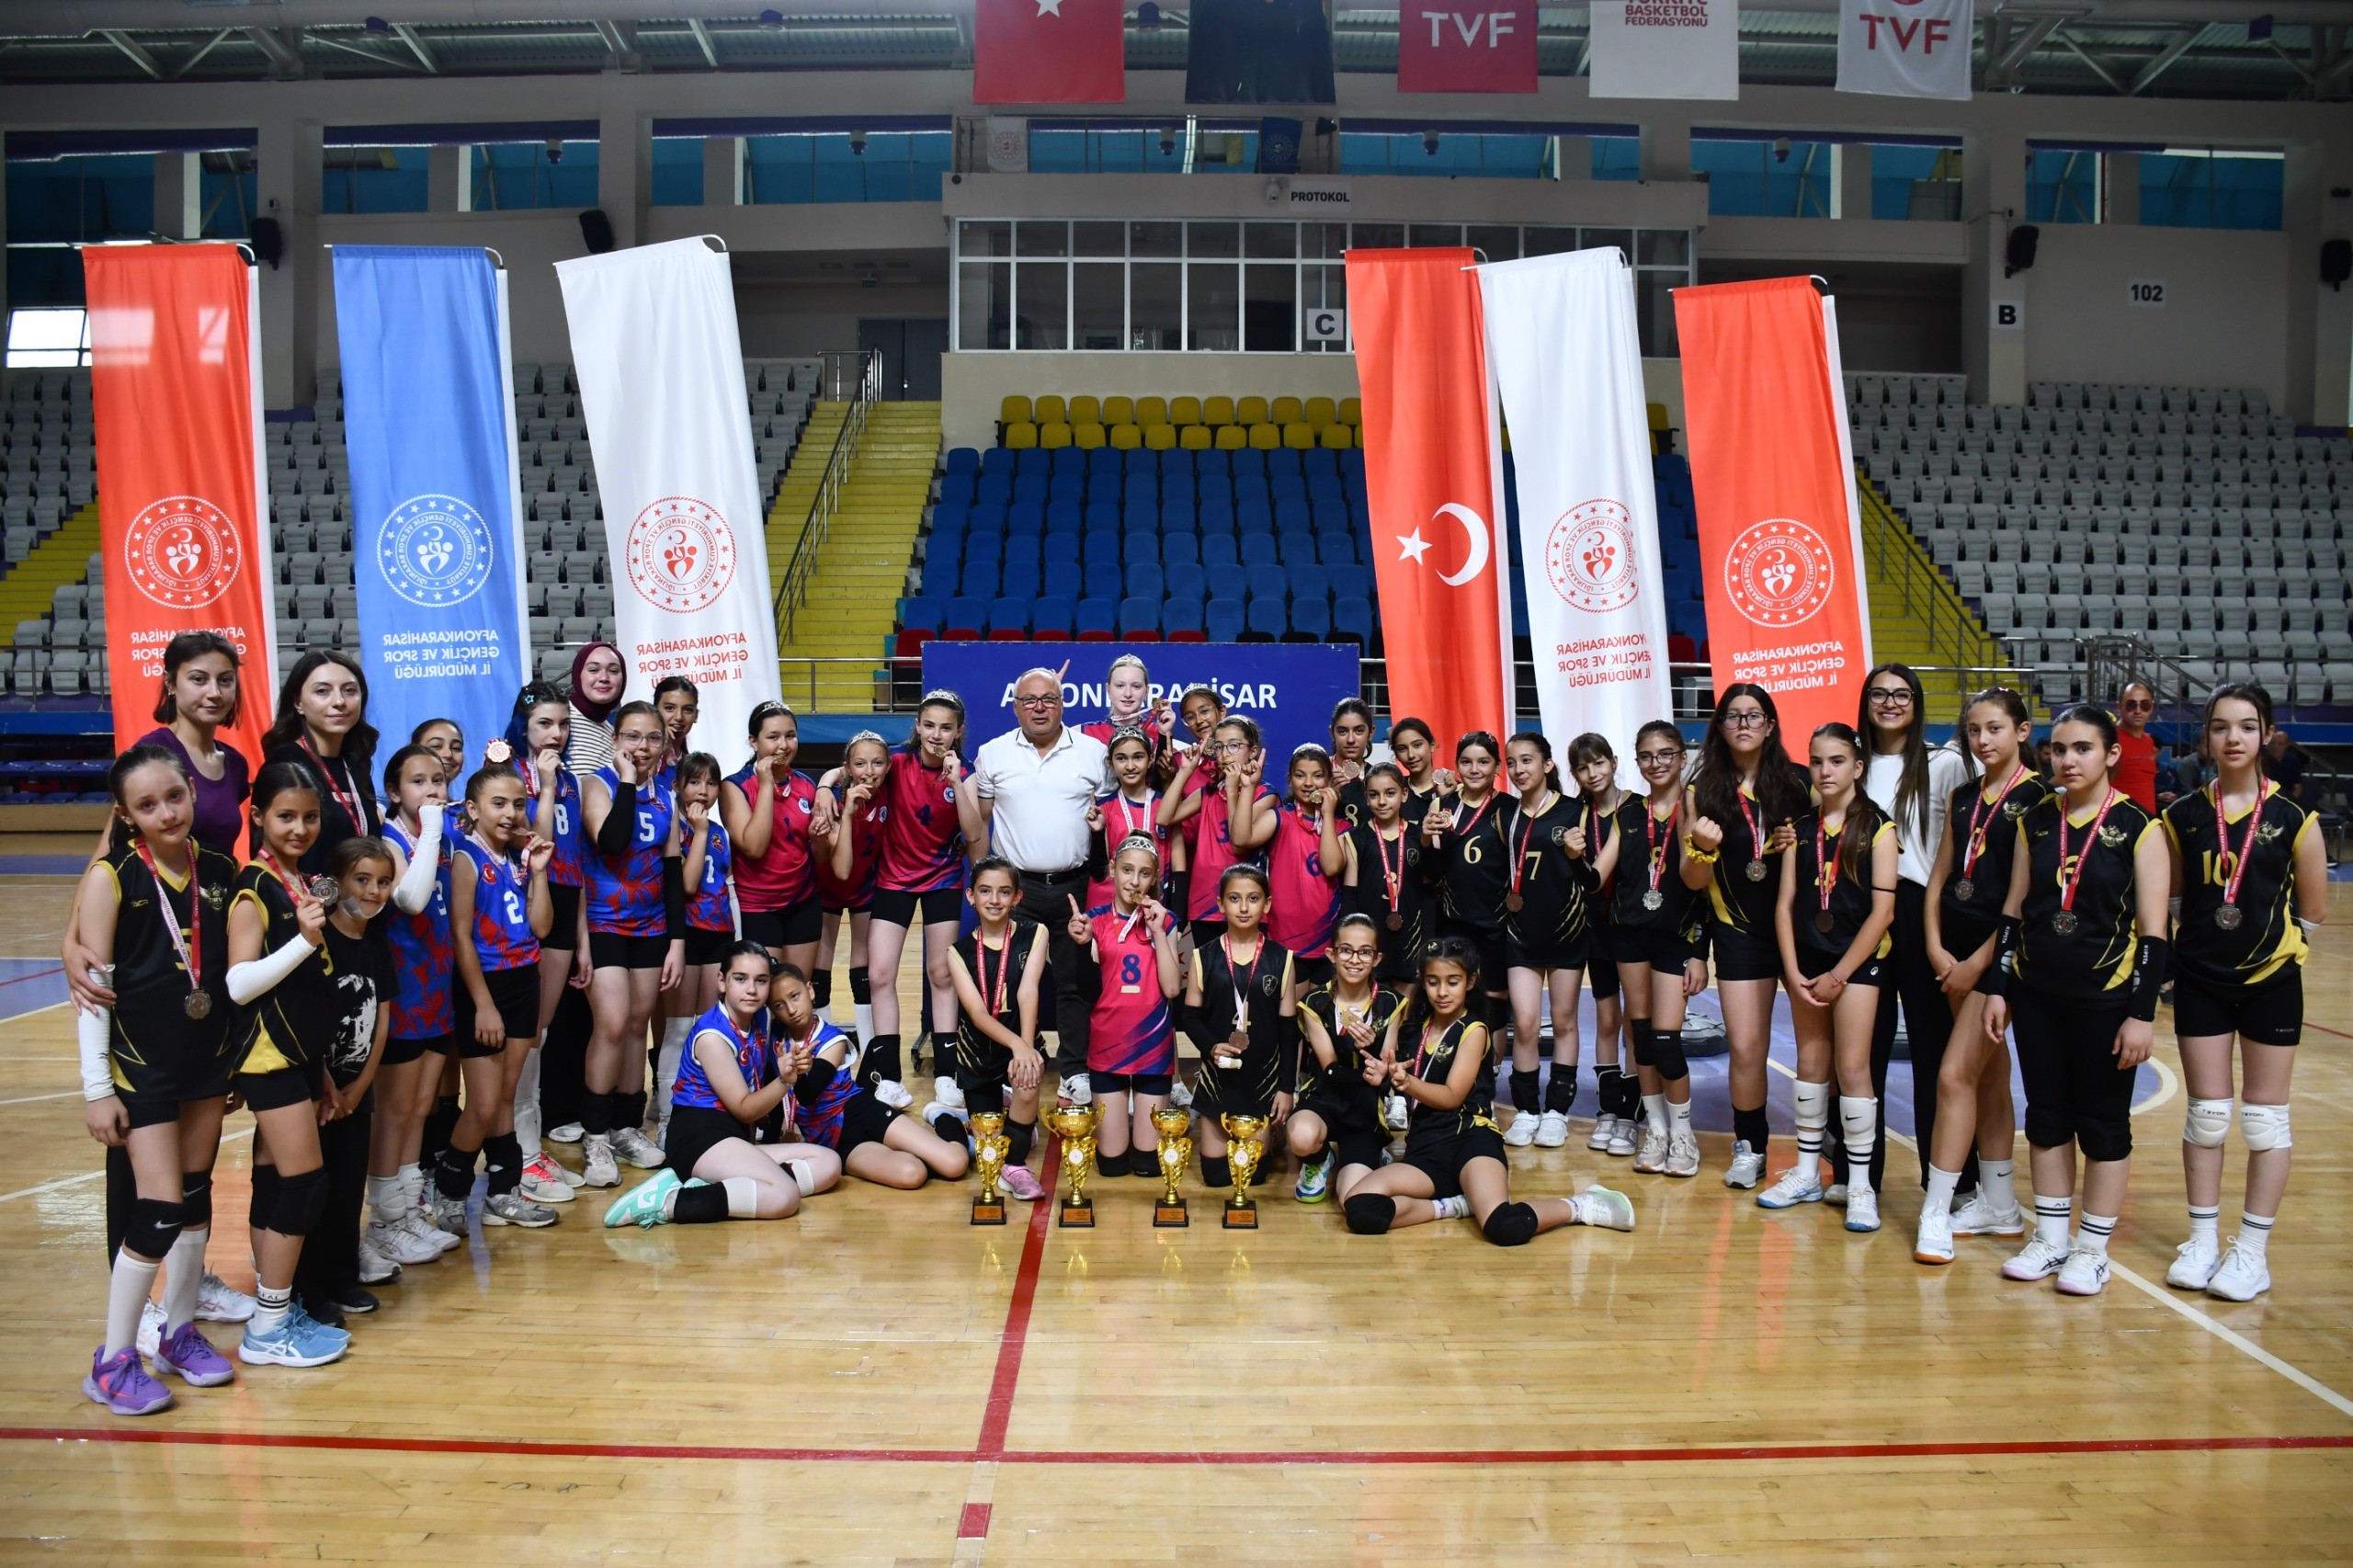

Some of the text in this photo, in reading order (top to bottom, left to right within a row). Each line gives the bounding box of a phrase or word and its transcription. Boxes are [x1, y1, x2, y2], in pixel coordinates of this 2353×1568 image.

[1625, 5, 1709, 17] BASKETBOL
[1625, 17, 1709, 28] FEDERASYONU
[1422, 11, 1517, 49] TVF
[1859, 14, 1951, 55] TVF
[1290, 191, 1350, 203] PROTOKOL
[2131, 283, 2164, 302] 102
[1314, 313, 1336, 335] C
[1998, 304, 2017, 325] B
[553, 803, 570, 835] 8
[638, 812, 655, 842] 5
[915, 804, 933, 826] 4
[1305, 851, 1322, 877] 6
[1463, 835, 1482, 864] 6
[1525, 851, 1542, 881] 7
[1814, 861, 1836, 893] 4
[2056, 855, 2080, 890] 6
[2201, 849, 2238, 887] 10
[504, 891, 524, 925] 2
[2001, 926, 2010, 944] KIPSTA
[1120, 954, 1142, 984] 8
[1231, 1001, 1252, 1033] 4
